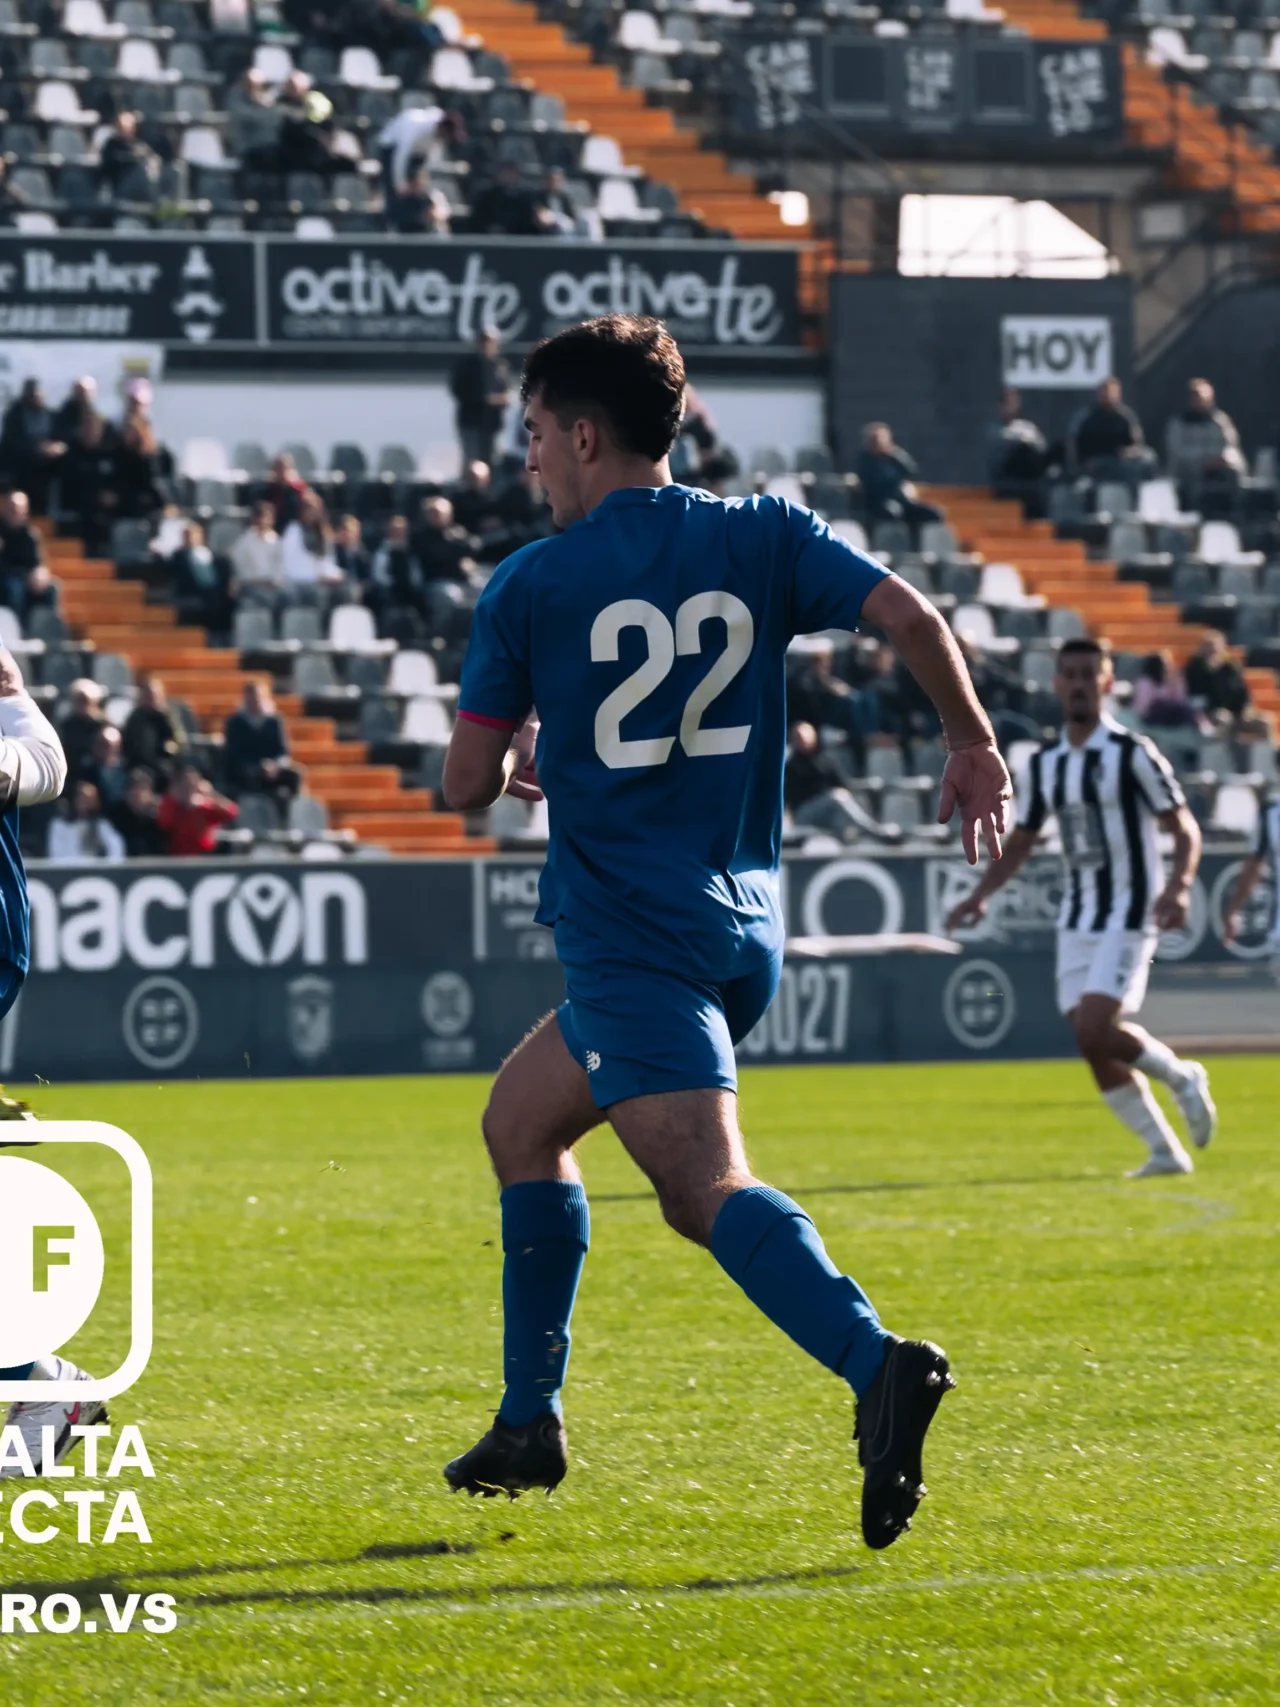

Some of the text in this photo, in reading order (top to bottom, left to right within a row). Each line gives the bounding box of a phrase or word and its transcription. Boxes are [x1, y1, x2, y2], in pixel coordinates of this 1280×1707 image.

[23, 248, 160, 294] Barber
[1008, 332, 1104, 372] HOY
[590, 590, 754, 769] 22
